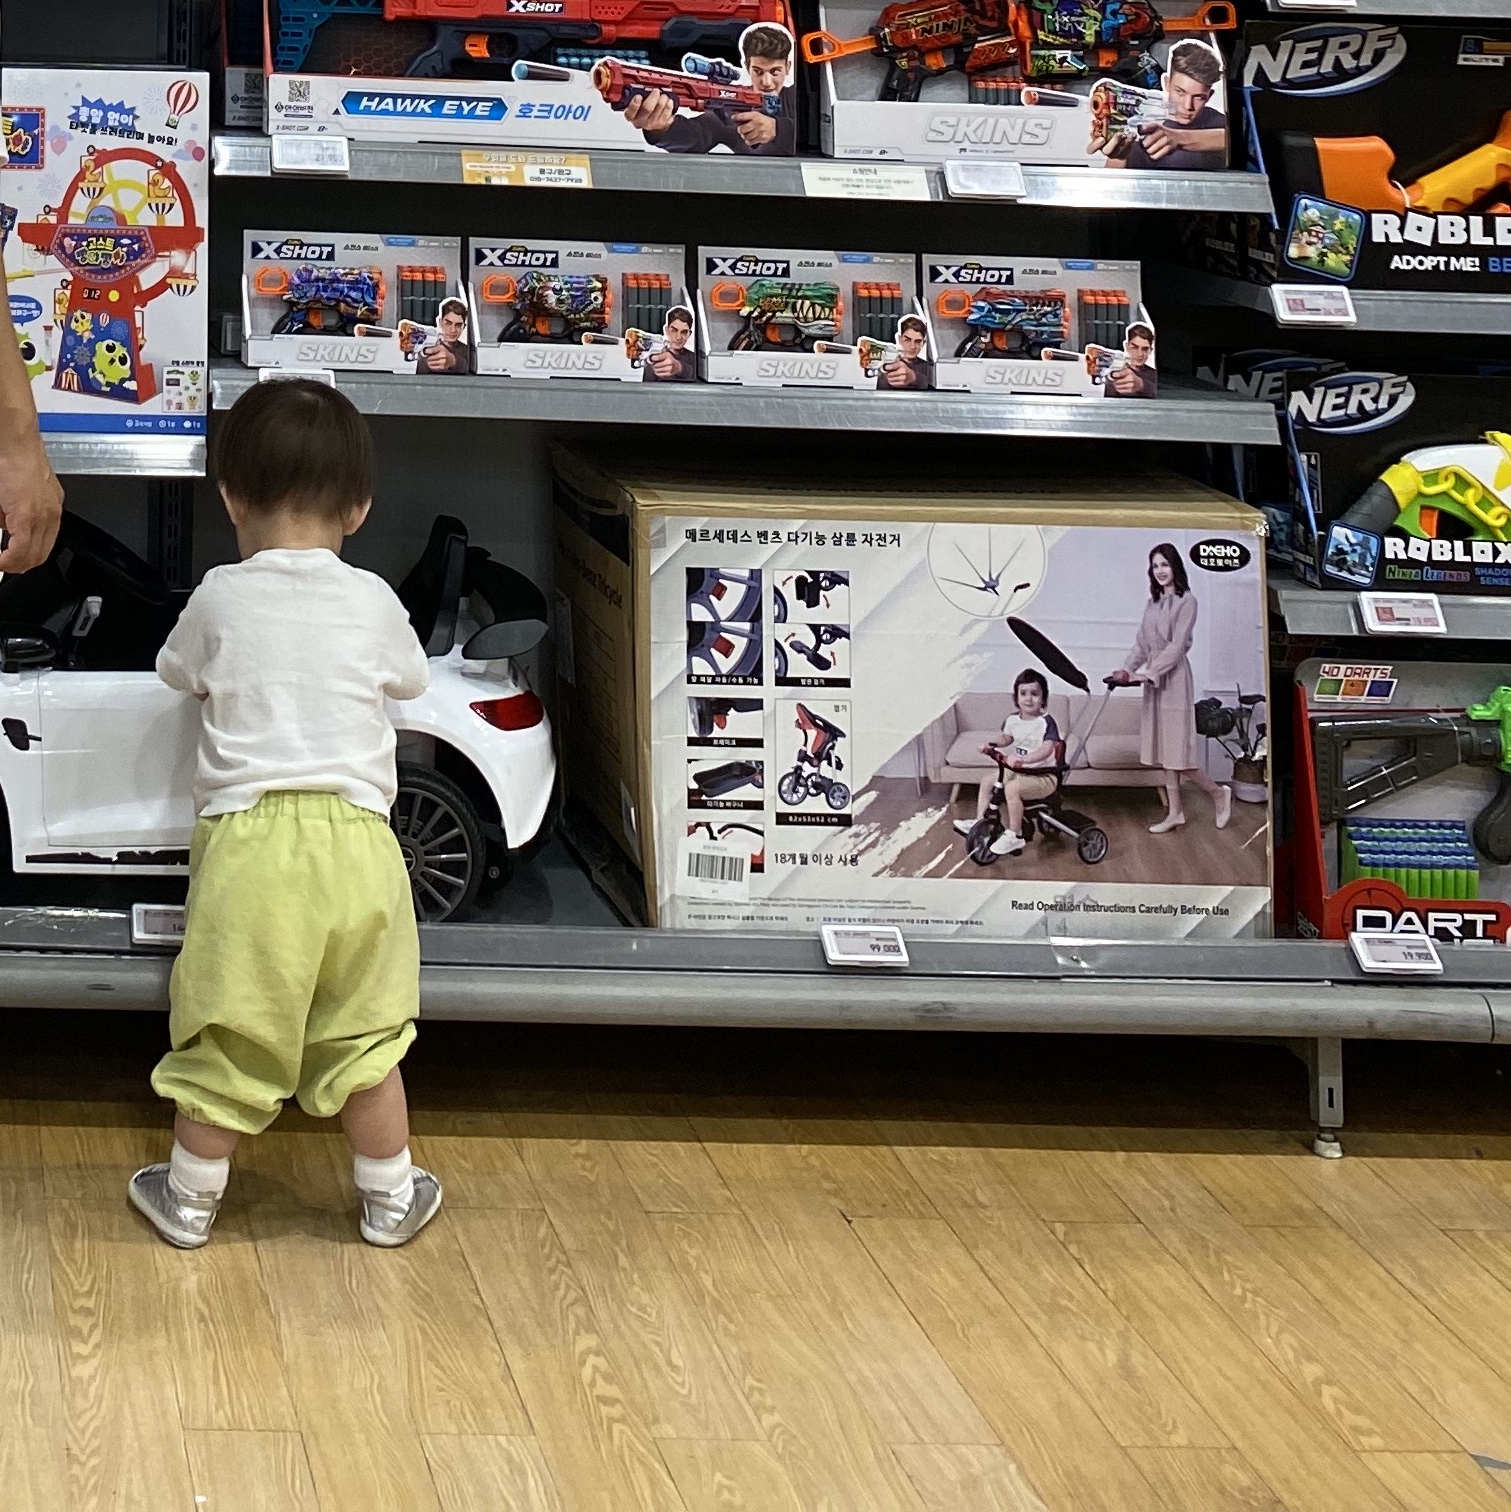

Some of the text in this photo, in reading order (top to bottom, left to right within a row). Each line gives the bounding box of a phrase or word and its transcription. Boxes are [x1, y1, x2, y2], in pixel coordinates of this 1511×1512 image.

[1244, 26, 1401, 88] NERF
[359, 97, 493, 115] HAWK EYE
[514, 101, 592, 122] 호크아이
[925, 115, 1057, 147] SKINS
[1390, 256, 1480, 271] ADOPT ME!
[298, 342, 377, 364] SKINS
[524, 349, 604, 372] SKINS
[758, 359, 837, 380] SKINS
[985, 365, 1065, 388] SKINS
[1288, 375, 1409, 423] NERF
[684, 528, 901, 548] 메르세데스 벤츠 다기능 삼륜 자전거
[1321, 666, 1390, 678] 40 DARTS
[774, 852, 859, 866] 18개월 이상 사용
[1011, 900, 1230, 916] Read Operation Instructions Carefully Before Use
[1355, 908, 1497, 935] DART
